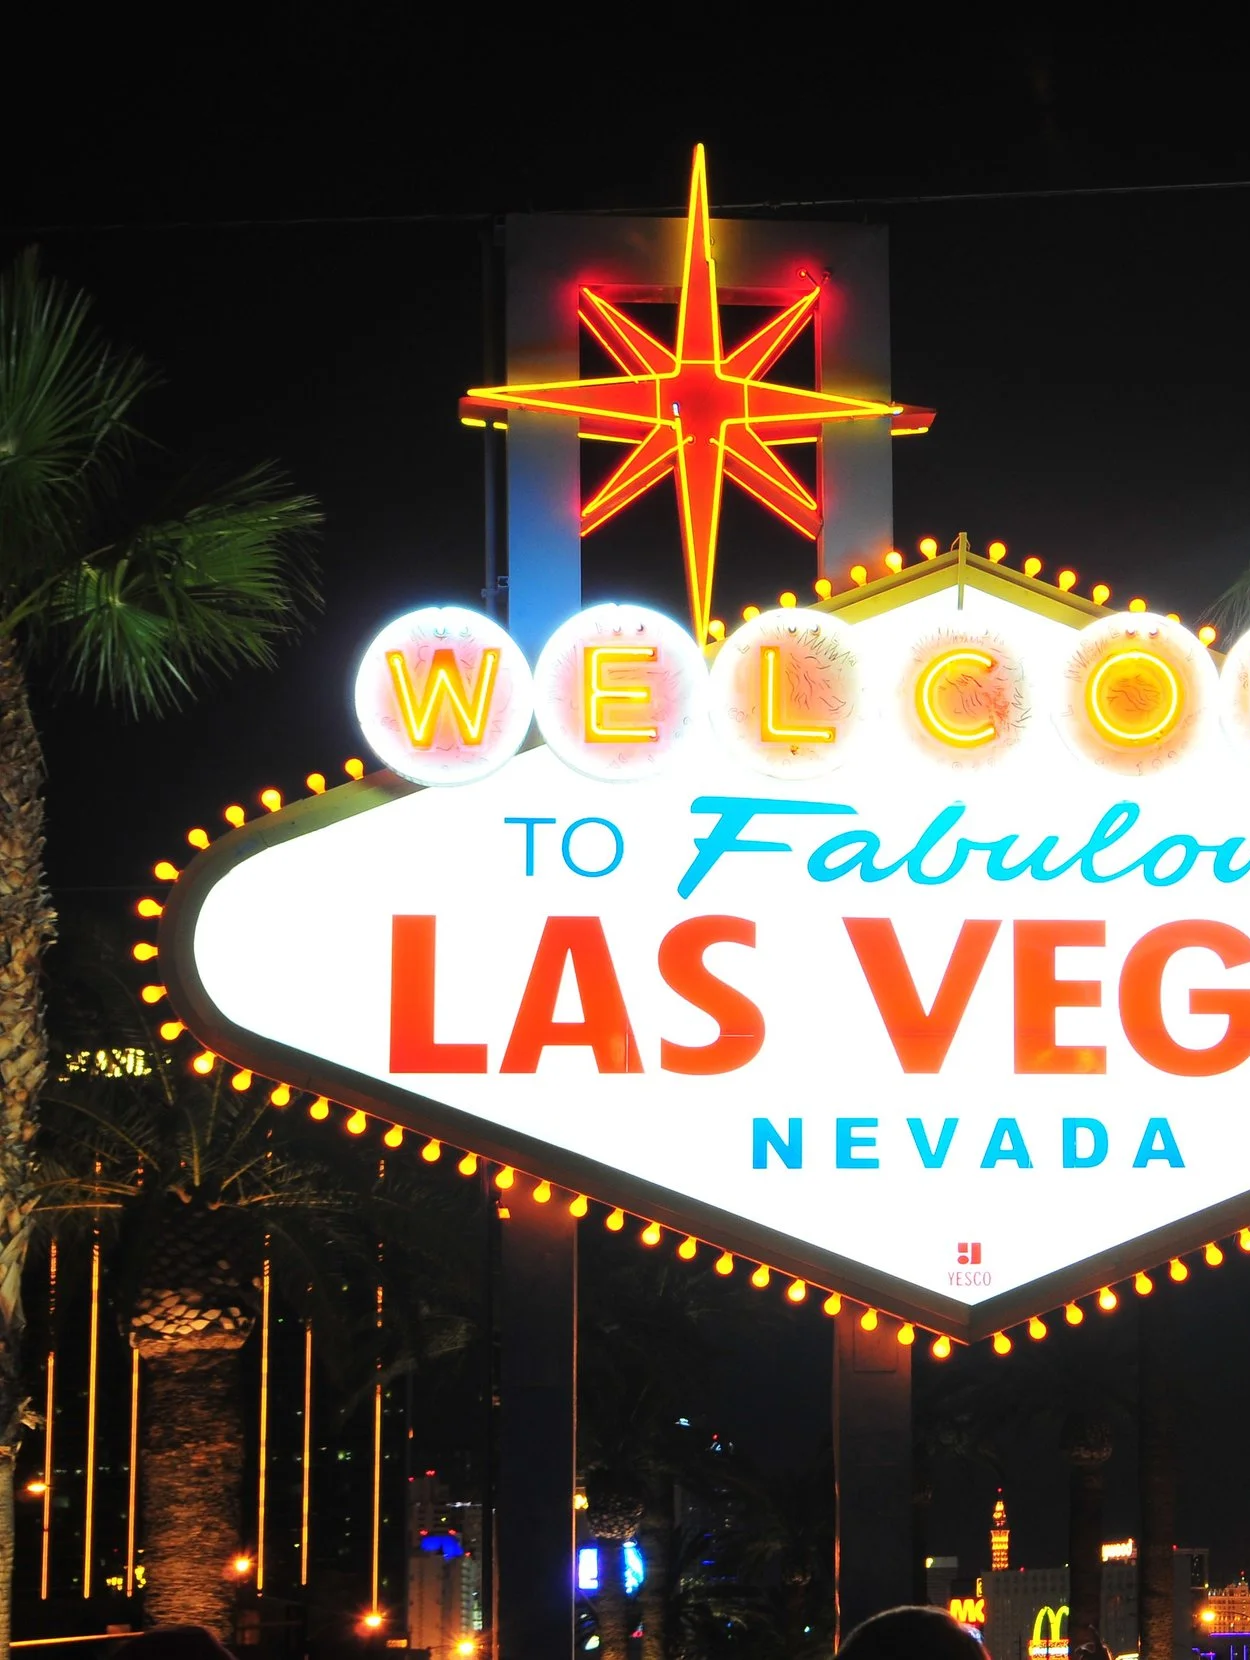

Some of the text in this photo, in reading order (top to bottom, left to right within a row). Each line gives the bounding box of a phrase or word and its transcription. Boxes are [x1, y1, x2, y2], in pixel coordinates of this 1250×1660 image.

[504, 817, 624, 877] TO
[390, 915, 766, 1075] LAS
[752, 1117, 1186, 1170] NEVADA
[947, 1271, 992, 1287] YESCO
